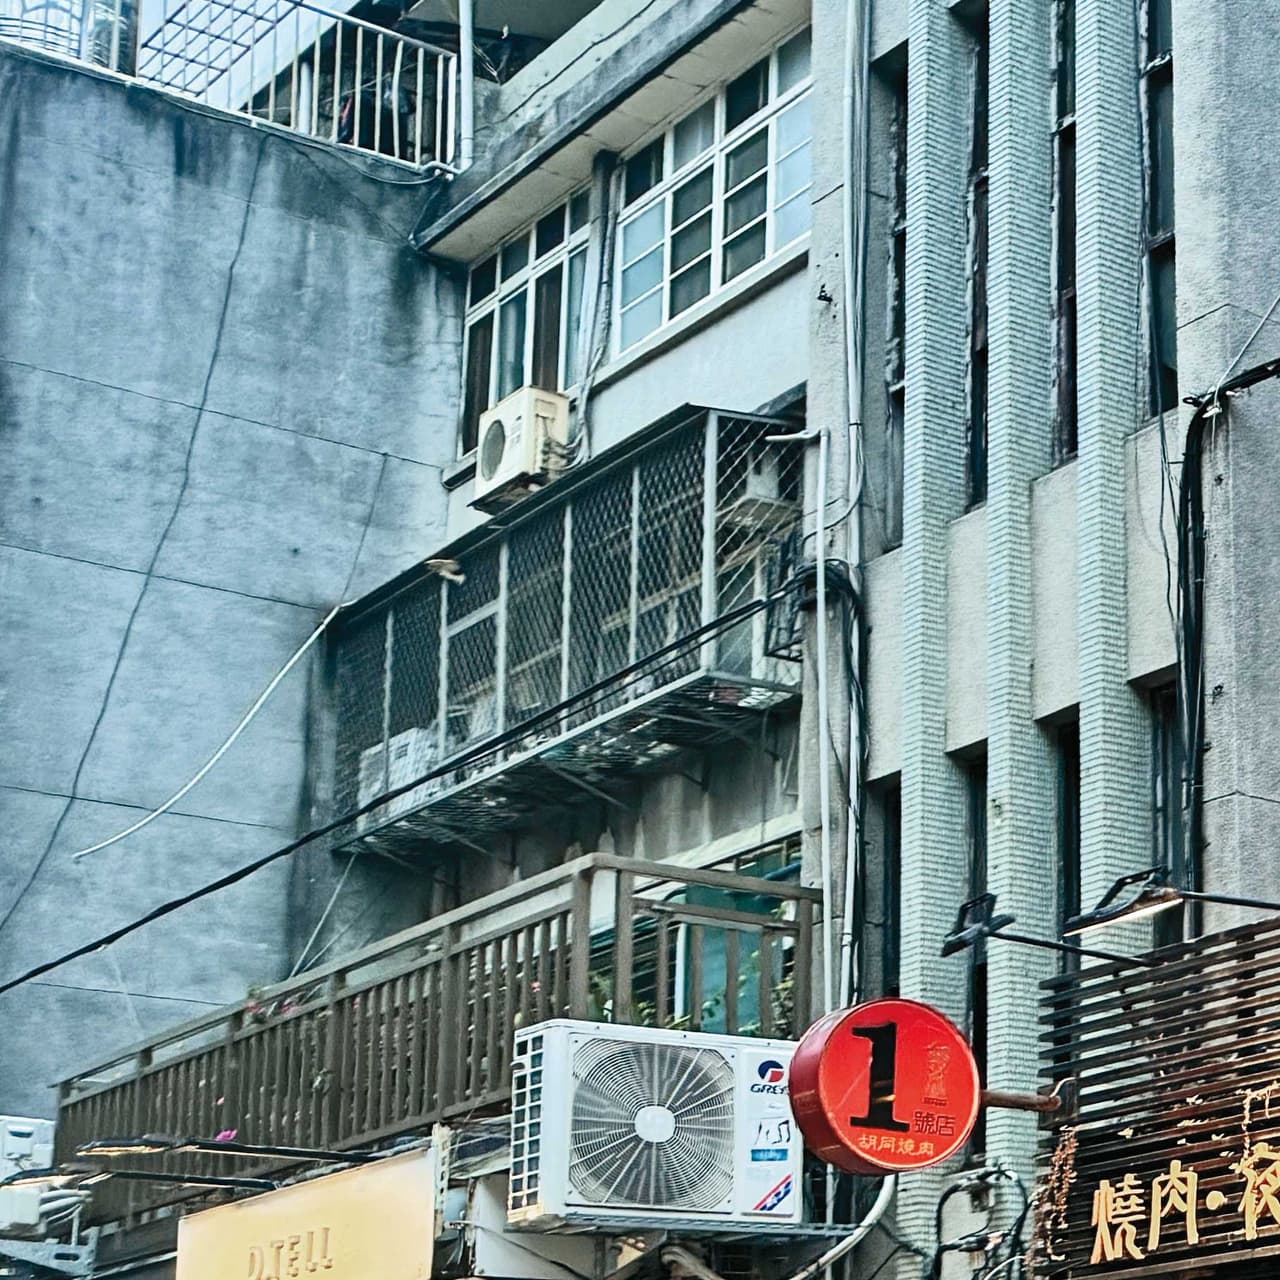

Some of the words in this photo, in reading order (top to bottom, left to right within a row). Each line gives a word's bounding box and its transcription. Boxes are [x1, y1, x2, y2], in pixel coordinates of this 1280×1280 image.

[849, 1021, 910, 1133] 1
[914, 1111, 956, 1137] 號店
[857, 1134, 935, 1156] 胡同燒肉
